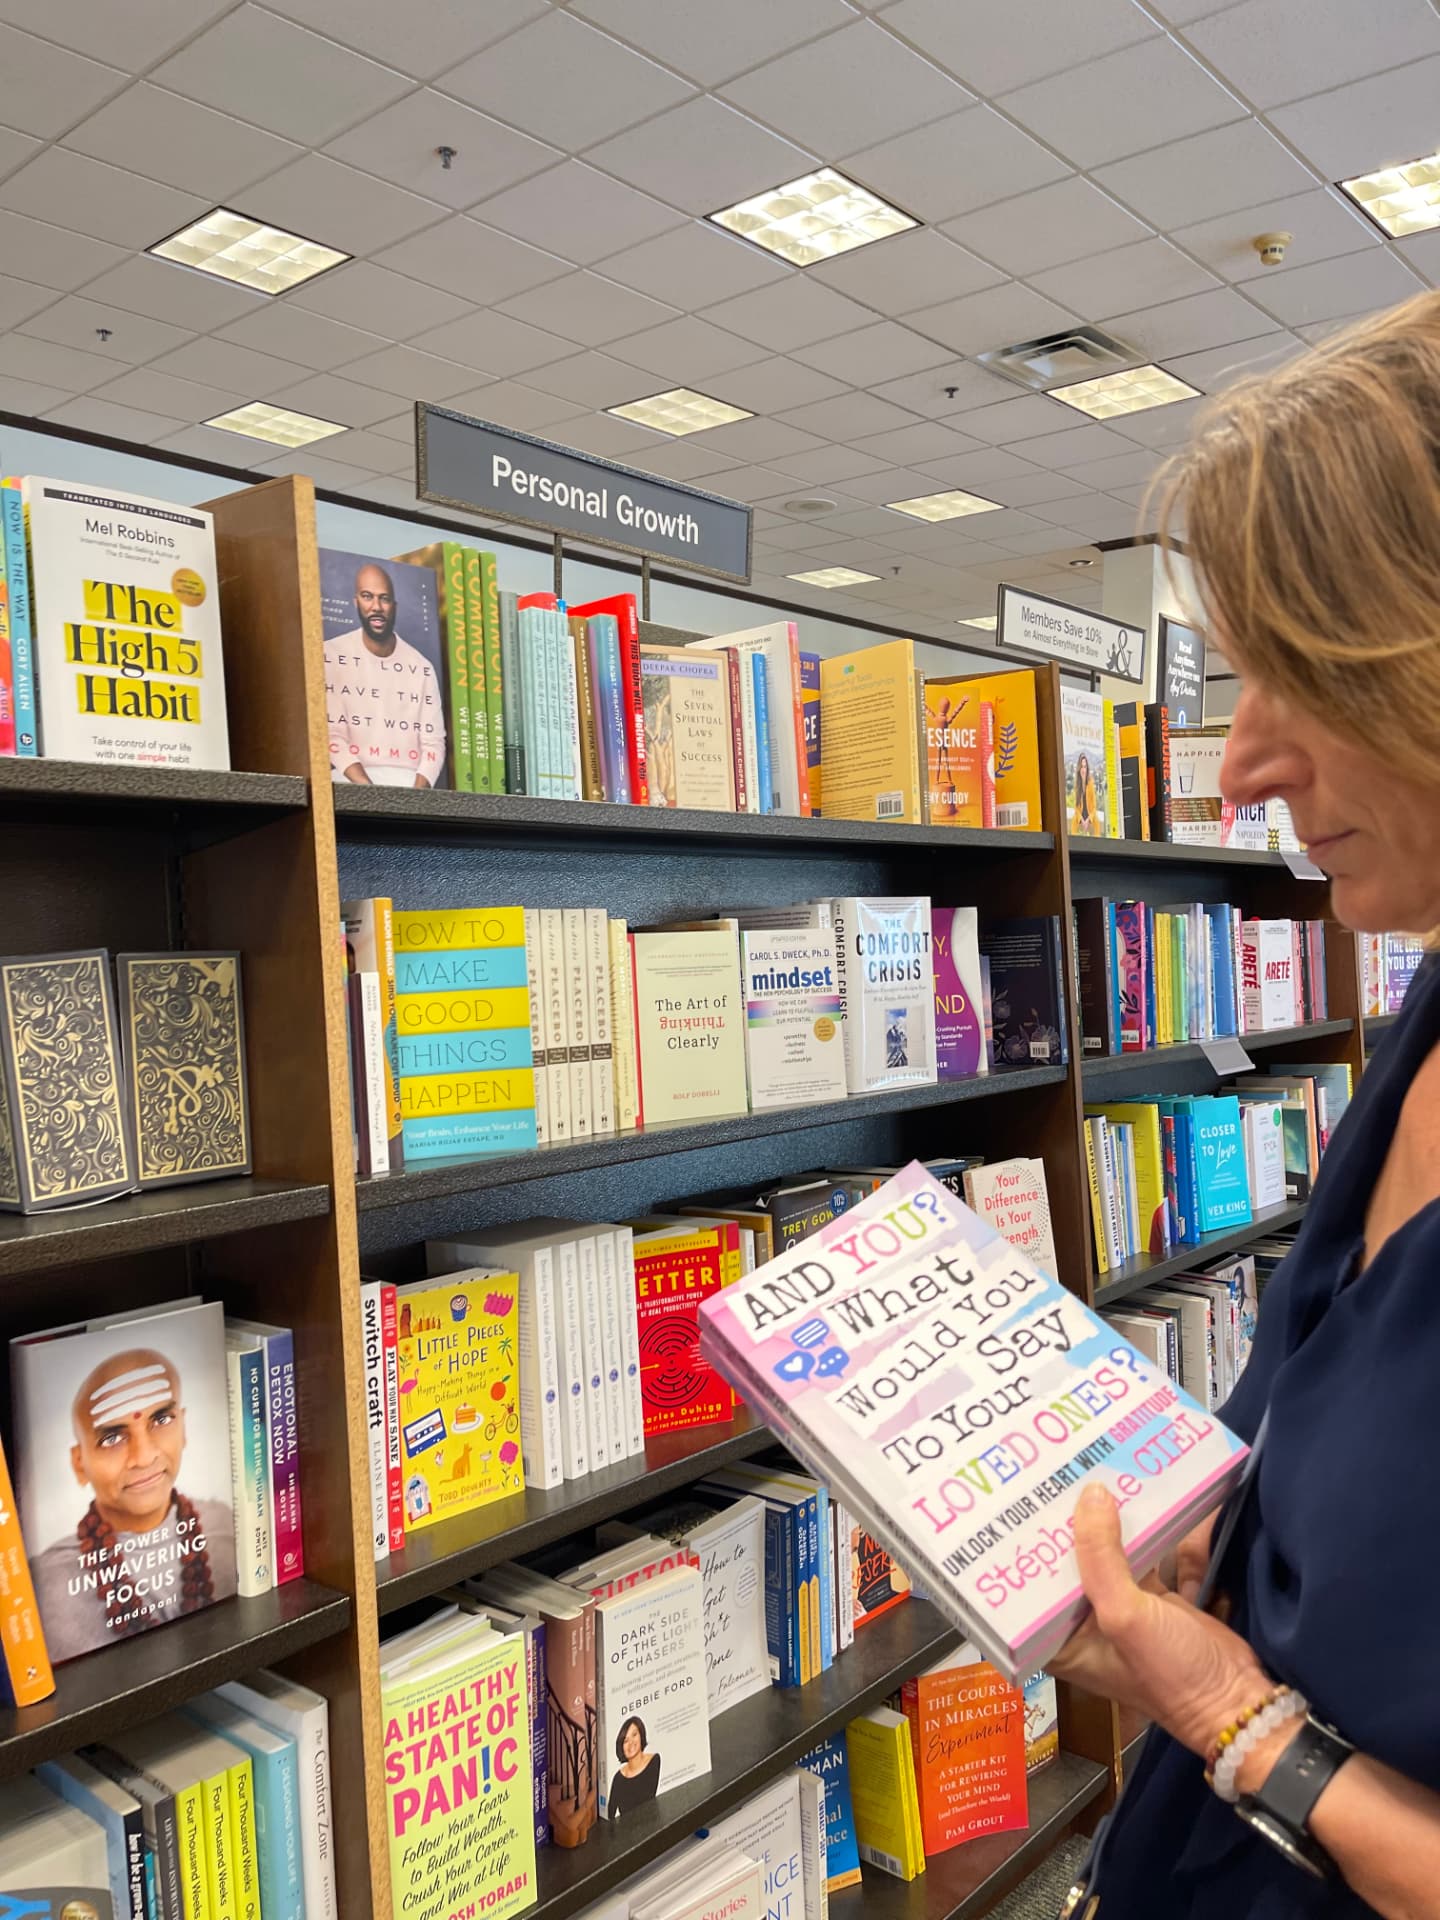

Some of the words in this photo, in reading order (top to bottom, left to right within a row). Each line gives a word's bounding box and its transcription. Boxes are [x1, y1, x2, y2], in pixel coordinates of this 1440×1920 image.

[149, 507, 192, 524] LANGUAGES
[492, 454, 608, 519] Personal
[616, 494, 699, 545] Growth
[10, 501, 21, 536] NOW
[85, 518, 113, 536] Mel
[117, 524, 176, 548] Robbins
[15, 594, 25, 622] WAY
[91, 581, 176, 629] The
[450, 552, 468, 688] COMMON
[467, 558, 486, 692] COMMON
[1021, 605, 1062, 632] Members
[1064, 619, 1083, 639] Save
[1084, 626, 1103, 645] 10%
[16, 638, 28, 671] CORY
[71, 623, 169, 678] High
[177, 638, 199, 676] 5
[1032, 630, 1052, 644] Almost
[1053, 635, 1079, 655] Everything
[323, 653, 361, 667] LET
[380, 661, 432, 677] LOVE
[643, 663, 677, 674] DEEPAK
[679, 665, 714, 676] CHOPRA
[18, 674, 31, 711] ALLEN
[84, 675, 193, 722] Habit
[325, 684, 380, 699] HAVE
[397, 692, 433, 705] THE
[683, 700, 714, 712] SEVEN
[327, 713, 372, 727] LAST
[383, 718, 435, 734] WORD
[458, 706, 469, 725] WE
[675, 712, 723, 726] SPIRITUAL
[688, 727, 713, 738] LAWS
[92, 735, 113, 746] Take
[114, 738, 147, 749] control
[148, 740, 157, 750] of
[159, 742, 177, 752] your
[179, 743, 192, 753] life
[96, 750, 116, 760] with
[118, 752, 135, 760] one
[328, 743, 437, 762] COMMON
[681, 751, 723, 763] SUCCESS
[1160, 706, 1171, 781] ENDURE
[941, 791, 969, 805] CUDDY
[1182, 824, 1218, 832] HARRIS
[464, 919, 506, 943] TO
[884, 919, 902, 928] THE
[385, 941, 394, 977] DERULO
[750, 951, 772, 961] CAROL
[835, 918, 846, 975] COMFORT
[855, 931, 930, 957] COMFORT
[404, 959, 489, 986] MAKE
[752, 966, 833, 991] mindset
[868, 959, 922, 983] CRISIS
[1264, 956, 1291, 981] ARETÉ
[1388, 955, 1405, 970] YOU
[402, 1000, 494, 1027] GOOD
[528, 968, 540, 1047] PLACEBO
[550, 966, 562, 1043] PLACEBO
[573, 966, 585, 1042] PLACEBO
[595, 965, 607, 1040] PLACEBO
[655, 998, 682, 1011] The
[686, 997, 709, 1010] Art
[713, 995, 728, 1008] of
[838, 979, 848, 1020] CRISIS
[667, 1034, 720, 1050] Clearly
[1200, 1123, 1236, 1139] CLOSER
[1087, 1139, 1099, 1196] IMPOSSIBLE
[1201, 1144, 1215, 1157] TO
[995, 1175, 1021, 1188] Your
[984, 1190, 1039, 1211] Difference
[1207, 1202, 1224, 1216] VEX
[1226, 1200, 1247, 1213] KING
[782, 1218, 808, 1238] TREY
[996, 1214, 1005, 1228] Is
[1008, 1211, 1032, 1226] Your
[672, 1255, 707, 1267] FASTER
[743, 1260, 836, 1331] AND
[827, 1190, 947, 1276] YOU?
[826, 1254, 975, 1335] What
[365, 1298, 381, 1370] switch
[418, 1333, 459, 1361] LITTLE
[467, 1323, 505, 1347] PIECES
[835, 1319, 967, 1421] Would
[952, 1269, 1037, 1326] You
[976, 1307, 1072, 1376] Say
[387, 1351, 396, 1384] PLAY
[448, 1346, 489, 1374] HOPE
[270, 1366, 283, 1420] DETOX
[368, 1375, 383, 1430] craft
[680, 1402, 723, 1417] Duhigg
[283, 1362, 298, 1461] EMOTIONAL
[881, 1434, 944, 1476] To
[930, 1375, 1032, 1444] Your
[273, 1425, 285, 1466] NOW
[389, 1425, 399, 1463] SANE
[911, 1430, 1040, 1535] LOVED
[1031, 1345, 1149, 1445] ONES?
[1132, 1412, 1214, 1478] CIEL
[942, 1522, 1004, 1577] UNLOCK
[997, 1495, 1039, 1534] YOUR
[1031, 1467, 1081, 1505] HEART
[1075, 1434, 1116, 1473] WITH
[1108, 1384, 1180, 1445] GRATITUDE
[77, 1548, 108, 1569] THE
[114, 1528, 169, 1557] POWER
[175, 1518, 196, 1535] OF
[68, 1534, 207, 1596] UNWAVERING
[702, 1551, 731, 1583] How
[106, 1568, 175, 1609] FOCUS
[620, 1620, 655, 1646] DARK
[660, 1607, 690, 1629] SIDE
[610, 1646, 628, 1665] OF
[633, 1635, 662, 1654] THE
[626, 1638, 686, 1672] CHASERS
[384, 1718, 404, 1748] A
[407, 1661, 518, 1738] HEALTHY
[620, 1689, 661, 1716] DEBBIE
[664, 1676, 694, 1696] FORD
[926, 1694, 954, 1713] THE
[925, 1717, 941, 1733] IN
[946, 1699, 1019, 1725] MIRACLES
[385, 1712, 483, 1785] STATE
[486, 1692, 520, 1736] OF
[926, 1713, 1018, 1765] Experiment
[948, 1759, 987, 1775] STARTER
[989, 1754, 1008, 1766] KIT
[959, 1768, 1008, 1788] REWIRING
[213, 1785, 222, 1814] Four
[237, 1773, 247, 1800] Four
[281, 1767, 292, 1830] DESIGNING
[313, 1748, 328, 1818] Comfort
[393, 1737, 519, 1838] PAN!C
[973, 1782, 1001, 1797] MIND
[186, 1797, 196, 1825] Four
[238, 1800, 252, 1856] Thousand
[944, 1824, 966, 1840] PAM
[968, 1814, 1005, 1832] GROUT
[214, 1815, 227, 1866] Thousand
[317, 1820, 330, 1860] Zone
[401, 1832, 444, 1868] Follow
[448, 1813, 475, 1839] Your
[477, 1789, 511, 1820] Fears
[188, 1826, 201, 1877] Thousand
[285, 1831, 296, 1862] YOUR
[410, 1868, 423, 1885] to
[426, 1839, 461, 1876] Build
[217, 1868, 228, 1908] Weeks
[242, 1856, 252, 1894] Weeks
[288, 1862, 297, 1885] LIFE
[402, 1874, 442, 1912] Crush
[445, 1859, 473, 1885] Your
[448, 1880, 471, 1905] Win
[473, 1865, 487, 1887] at
[489, 1851, 511, 1877] Life
[192, 1878, 202, 1918] Weeks
[478, 1871, 528, 1912] TORABI
